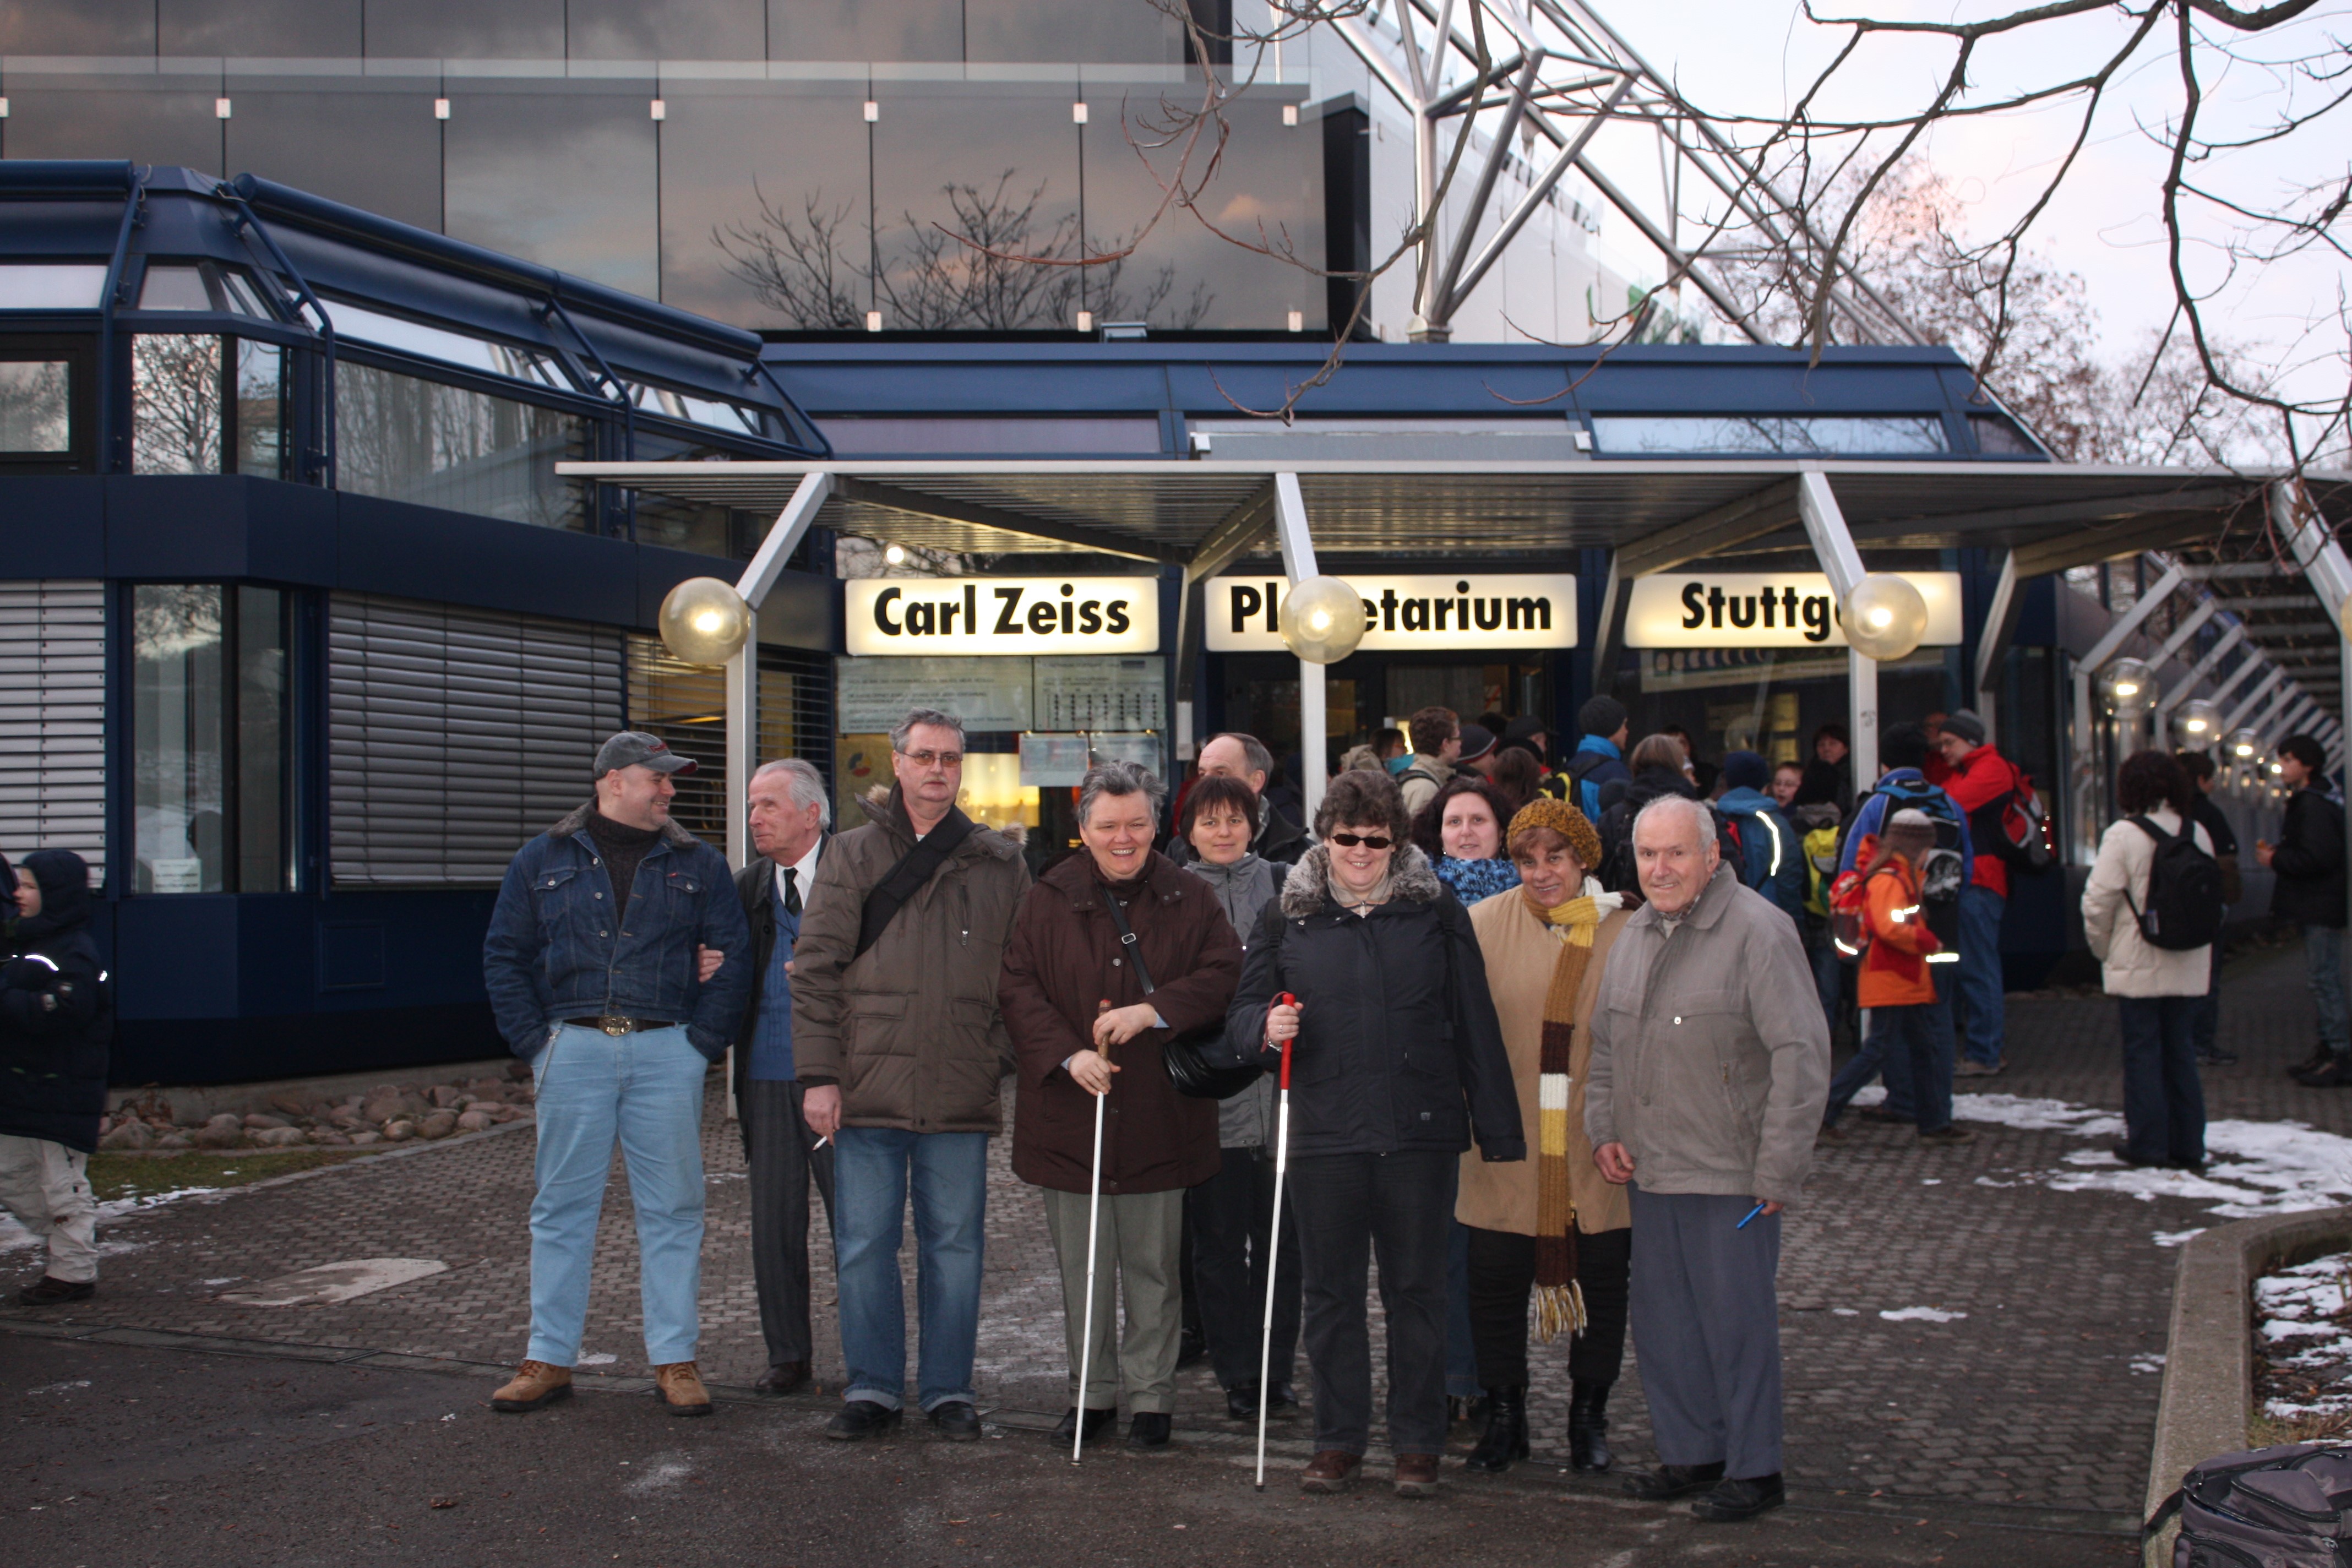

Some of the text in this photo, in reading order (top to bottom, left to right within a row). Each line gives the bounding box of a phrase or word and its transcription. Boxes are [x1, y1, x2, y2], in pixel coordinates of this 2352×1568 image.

[874, 584, 1130, 636] Carl Zeiss
[1231, 580, 1551, 633] Pltarium
[1681, 582, 1842, 643] Stuttg
